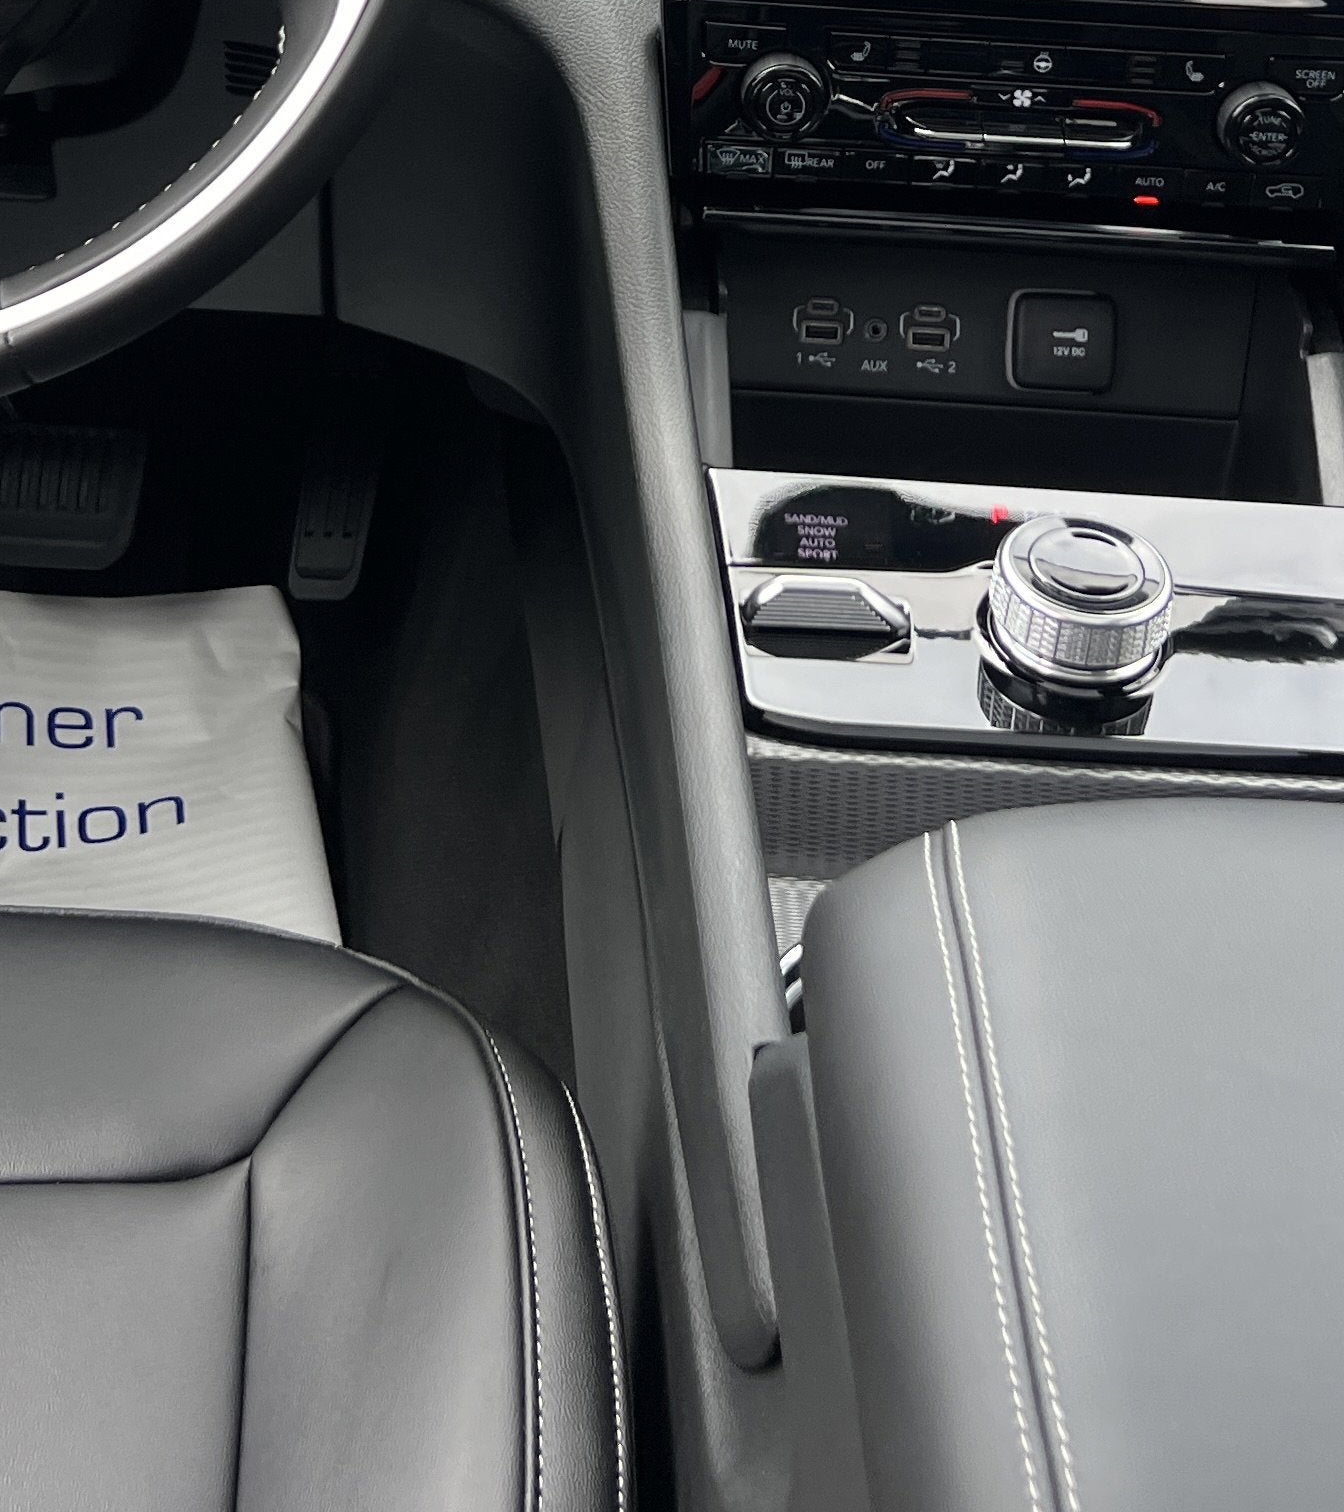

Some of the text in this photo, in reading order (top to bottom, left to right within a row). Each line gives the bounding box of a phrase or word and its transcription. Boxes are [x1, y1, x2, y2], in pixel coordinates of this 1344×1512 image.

[727, 39, 758, 50] MUTE
[1295, 69, 1336, 80] SCREEN
[1306, 79, 1326, 88] OFF
[1252, 131, 1286, 142] ENTER
[739, 154, 765, 164] MAX
[806, 158, 835, 169] REAR
[865, 160, 887, 169] OFF
[1135, 177, 1164, 187] AUTO
[1206, 182, 1226, 191] A/C
[1053, 346, 1086, 357] 12V DC
[796, 351, 803, 365] 1
[861, 359, 888, 373] AUX
[948, 361, 957, 374] 2
[784, 513, 849, 526] SAND/MUD
[797, 525, 837, 537] SNOW
[799, 537, 836, 548] AUTO
[797, 548, 838, 561] SPORT
